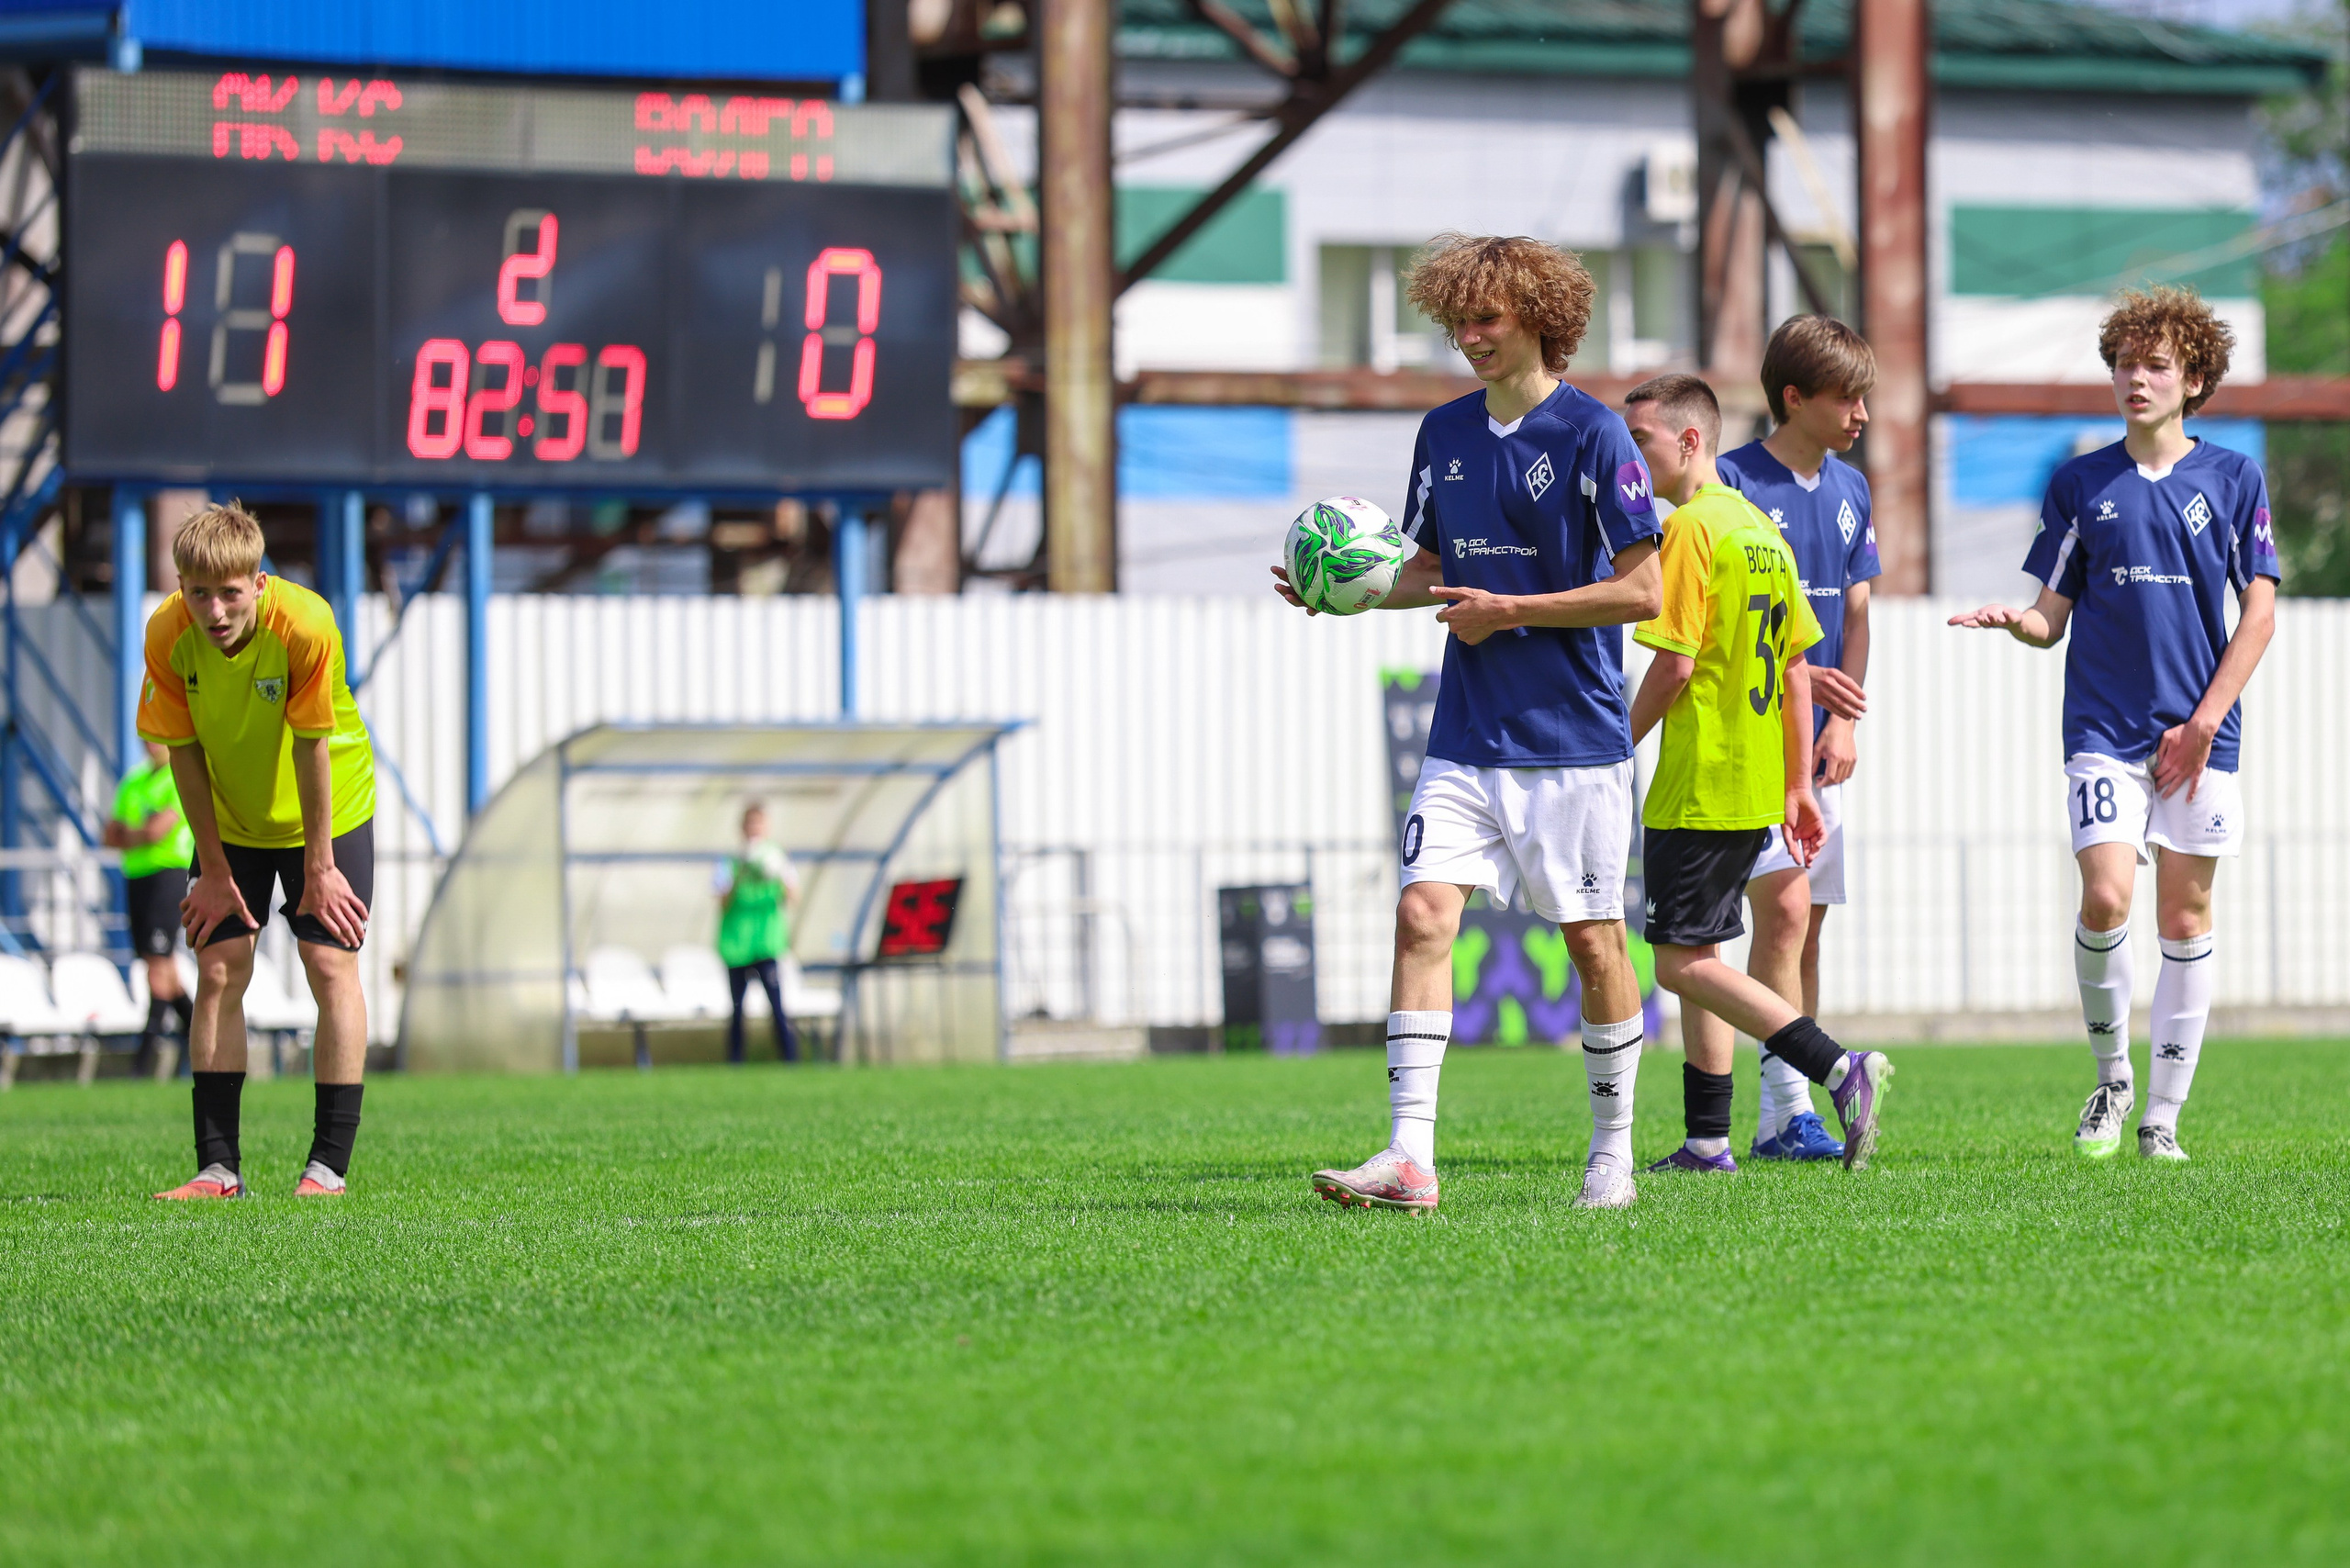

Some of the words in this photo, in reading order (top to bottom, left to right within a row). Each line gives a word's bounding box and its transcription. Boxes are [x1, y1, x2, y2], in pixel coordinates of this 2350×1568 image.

[634, 91, 834, 183] ВОЛГА
[497, 211, 558, 326] 2
[798, 247, 882, 420] 0
[407, 338, 647, 461] 82:57
[1468, 538, 1488, 547] ДСК
[2096, 512, 2120, 522] KELME
[1468, 545, 1538, 557] ТРАНССТРОЙ
[2130, 574, 2193, 586] ТРАНССТРО
[2076, 777, 2118, 829] 18
